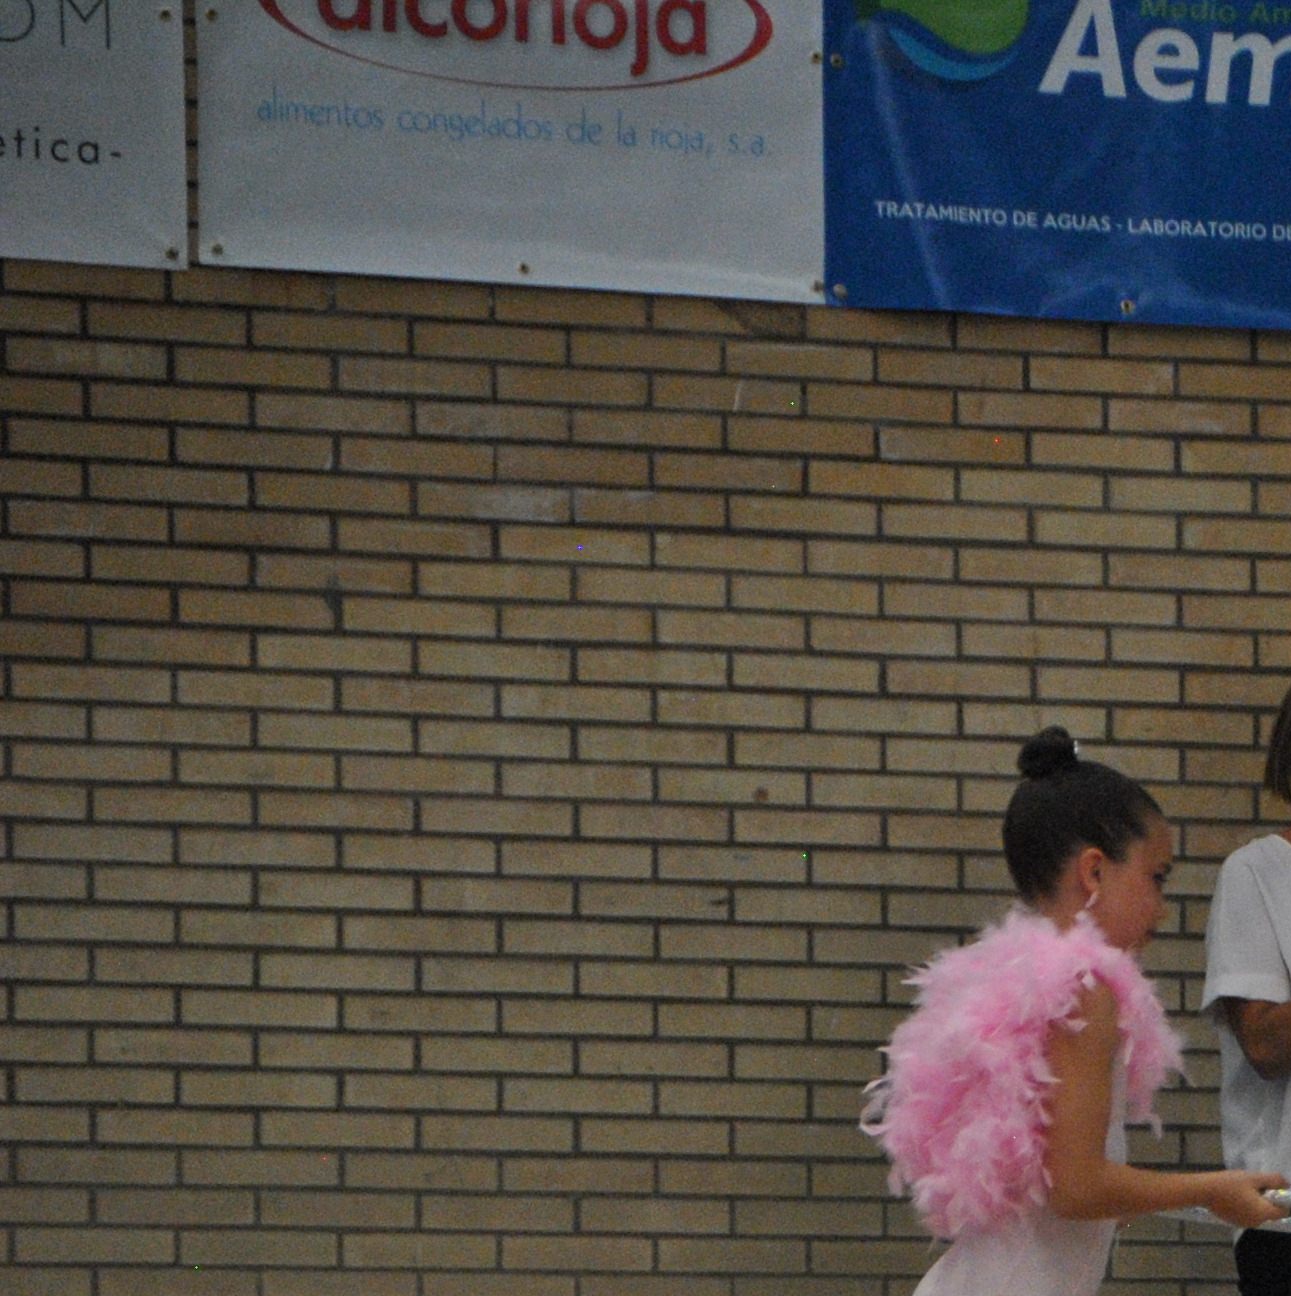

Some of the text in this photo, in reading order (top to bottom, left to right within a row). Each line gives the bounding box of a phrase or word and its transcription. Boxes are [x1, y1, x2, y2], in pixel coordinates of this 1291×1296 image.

[0, 125, 122, 166] tica-
[565, 107, 602, 144] de
[617, 108, 638, 148] la
[874, 199, 1008, 226] TRATAMIENTO
[1012, 208, 1038, 227] DE
[1042, 211, 1112, 233] AGUAS
[1127, 217, 1267, 241] LABORATORIO
